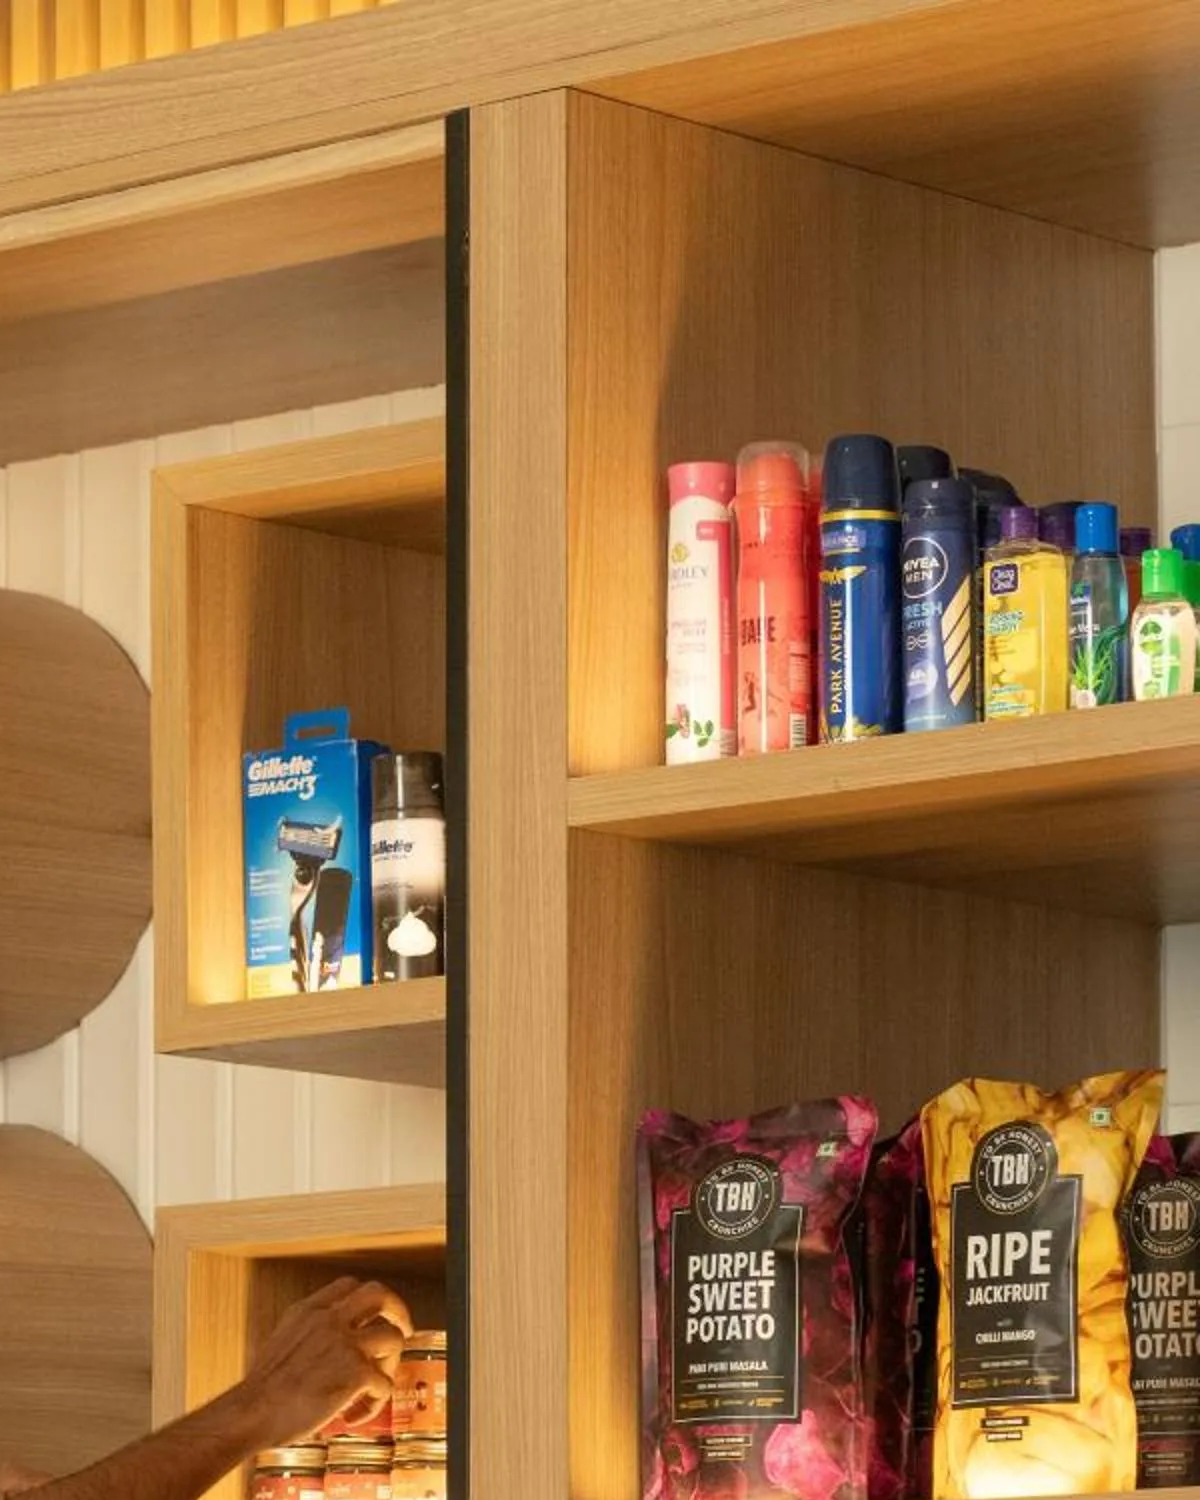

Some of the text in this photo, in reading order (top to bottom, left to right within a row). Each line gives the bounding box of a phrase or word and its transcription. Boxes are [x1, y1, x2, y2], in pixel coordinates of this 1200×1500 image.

[830, 599, 843, 714] PARK AVENUE
[248, 756, 313, 781] Gillette
[991, 1153, 1030, 1187] TBH
[715, 1182, 757, 1213] TBH
[1147, 1200, 1190, 1232] TBH
[688, 1250, 776, 1281] PURPLE
[966, 1230, 1053, 1280] RIPE
[688, 1280, 776, 1315] SWEET
[966, 1282, 1051, 1307] JACKFRUIT
[686, 1313, 776, 1345] POTATO
